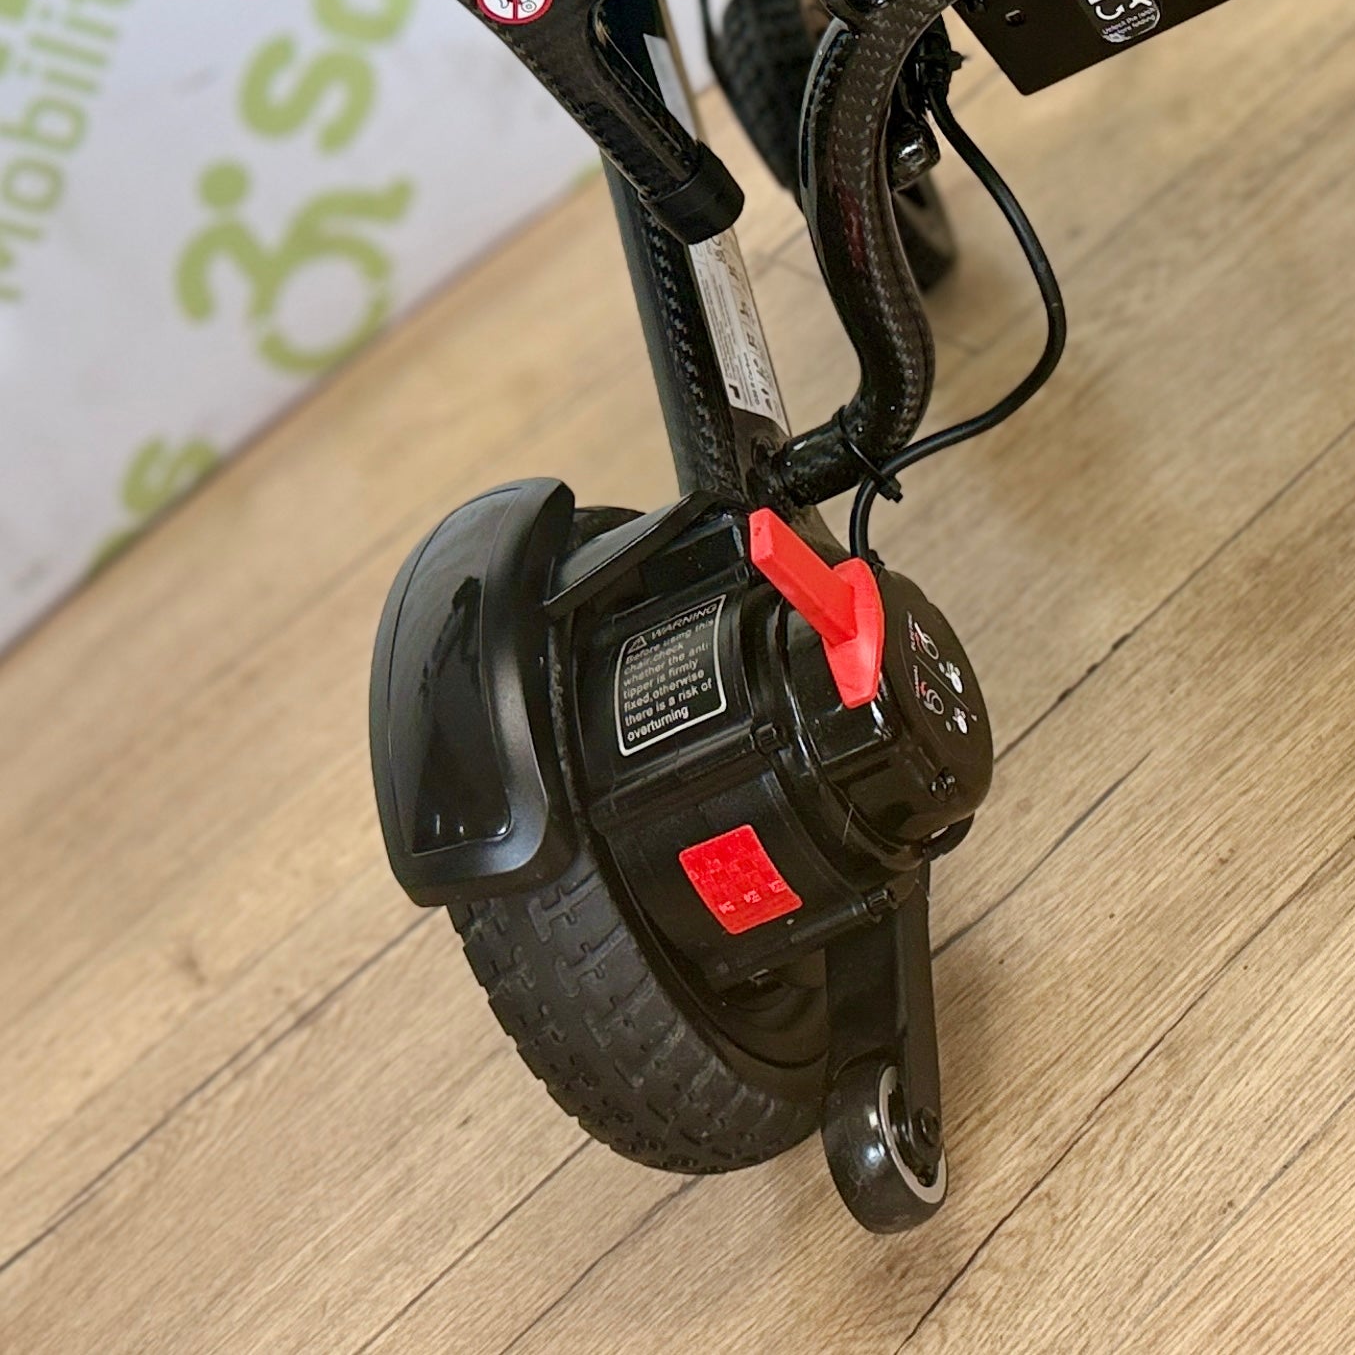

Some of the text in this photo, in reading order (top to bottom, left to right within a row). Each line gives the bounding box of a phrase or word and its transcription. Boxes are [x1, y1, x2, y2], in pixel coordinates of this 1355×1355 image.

[651, 604, 717, 639] WARNING
[626, 644, 661, 664] Before
[695, 619, 715, 632] this
[623, 659, 698, 699] tipper is firmly
[624, 661, 665, 686] whether
[668, 653, 685, 666] the
[625, 678, 712, 726] there is a risk of
[628, 707, 688, 741] overturning
